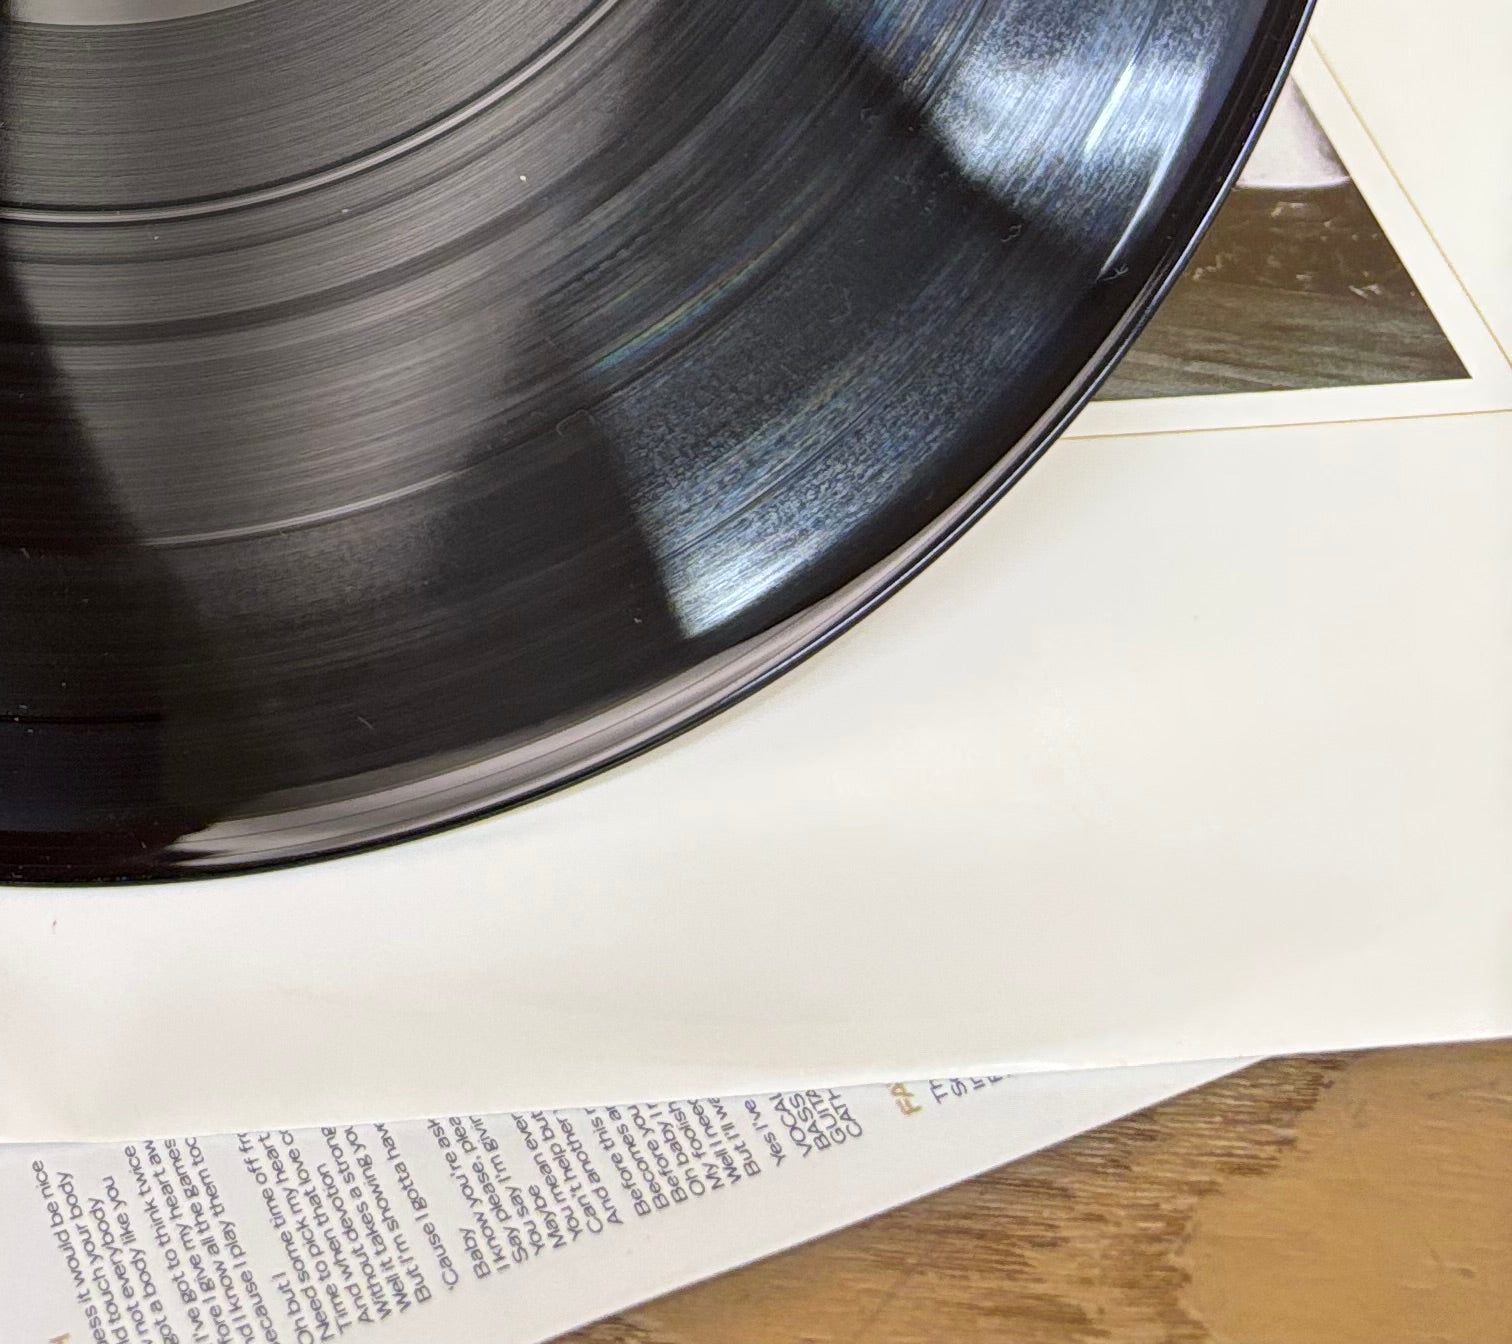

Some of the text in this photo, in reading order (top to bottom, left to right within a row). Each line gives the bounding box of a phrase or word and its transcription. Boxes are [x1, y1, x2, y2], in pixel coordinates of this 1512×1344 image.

[656, 1121, 690, 1168] baby
[667, 1100, 726, 1192] My foolish
[744, 1098, 787, 1168] Yes I've
[788, 1092, 833, 1152] BASS
[124, 1145, 152, 1198] twice
[163, 1138, 200, 1201] games
[320, 1126, 356, 1185] strong
[530, 1110, 604, 1235] Can't help but
[555, 1116, 625, 1226] And another
[590, 1116, 652, 1218] Before this
[616, 1123, 671, 1212] Becomes
[626, 1104, 689, 1205] Before you
[713, 1147, 742, 1185] Well
[720, 1121, 763, 1178] But I'll
[31, 1159, 55, 1200] nice
[101, 1175, 128, 1212] you
[152, 1166, 184, 1222] heart
[197, 1167, 226, 1218] them
[393, 1160, 428, 1212] gotta
[444, 1150, 484, 1209] you're
[533, 1151, 567, 1204] mean
[684, 1167, 706, 1198] Oh
[46, 1200, 65, 1229] be
[116, 1212, 137, 1247] like
[143, 1197, 172, 1249] think
[189, 1201, 211, 1235] the
[355, 1153, 433, 1304] But I'm showing
[356, 1200, 388, 1257] takes
[490, 1153, 546, 1257] You say I'm
[527, 1184, 568, 1251] Maybe
[560, 1204, 584, 1243] You
[52, 1228, 86, 1289] would
[56, 1171, 122, 1325] touch your body
[164, 1248, 181, 1271] to
[175, 1222, 197, 1252] my
[199, 1235, 221, 1256] all
[218, 1220, 247, 1260] play
[243, 1157, 336, 1343] Need some time off
[257, 1131, 353, 1336] Time to pick my heart
[288, 1147, 375, 1325] And when that love
[316, 1162, 393, 1321] Without devotion
[458, 1227, 492, 1280] Baby
[472, 1211, 507, 1264] know
[502, 1226, 530, 1265] Say
[87, 1197, 149, 1336] not everybody
[128, 1247, 157, 1300] body
[171, 1270, 198, 1306] got
[188, 1253, 217, 1294] give
[212, 1260, 243, 1315] know
[379, 1256, 395, 1273] it
[277, 1279, 302, 1317] but
[385, 1272, 412, 1314] Well
[293, 1316, 318, 1344] Oh
